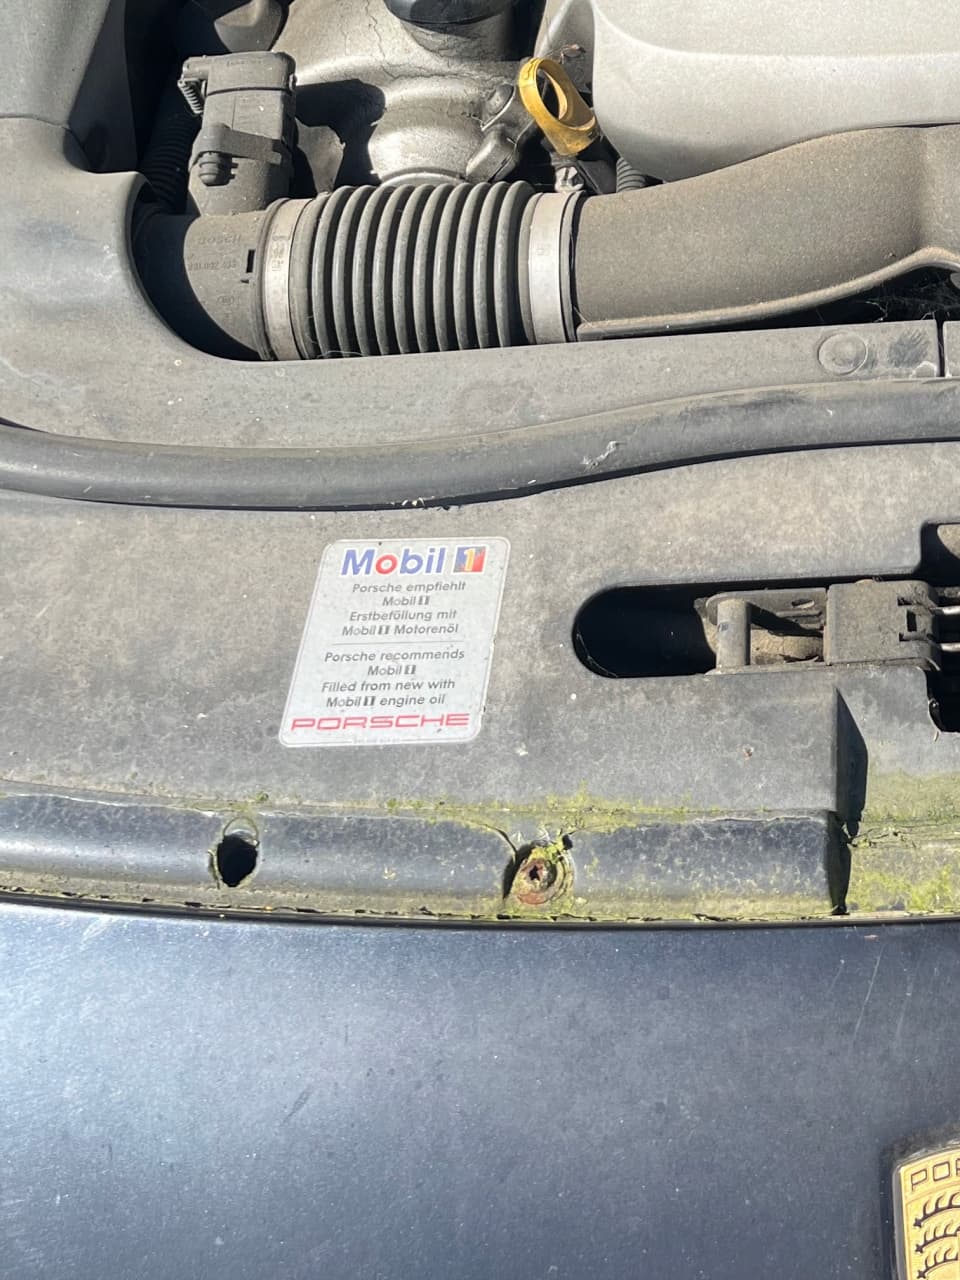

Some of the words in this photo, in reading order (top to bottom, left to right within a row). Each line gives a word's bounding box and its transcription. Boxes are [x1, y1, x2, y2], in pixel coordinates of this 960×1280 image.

[341, 547, 447, 576] Mobil
[352, 583, 402, 593] Porsche
[406, 581, 466, 593] empfiehlt
[382, 596, 416, 606] Mobil
[349, 609, 432, 621] Erstbefüllung
[436, 609, 457, 620] mit
[342, 625, 376, 636] Mobil
[394, 623, 459, 635] Motorenöl
[324, 652, 376, 662] Porsche
[380, 649, 465, 661] recommends
[367, 665, 402, 676] Mobil
[321, 681, 357, 692] Filled
[361, 680, 391, 691] from
[395, 681, 424, 690] new
[428, 679, 455, 690] with
[326, 696, 361, 707] Mobil
[379, 695, 425, 707] engine
[429, 694, 446, 705] oil
[290, 713, 470, 732] PORSCHE
